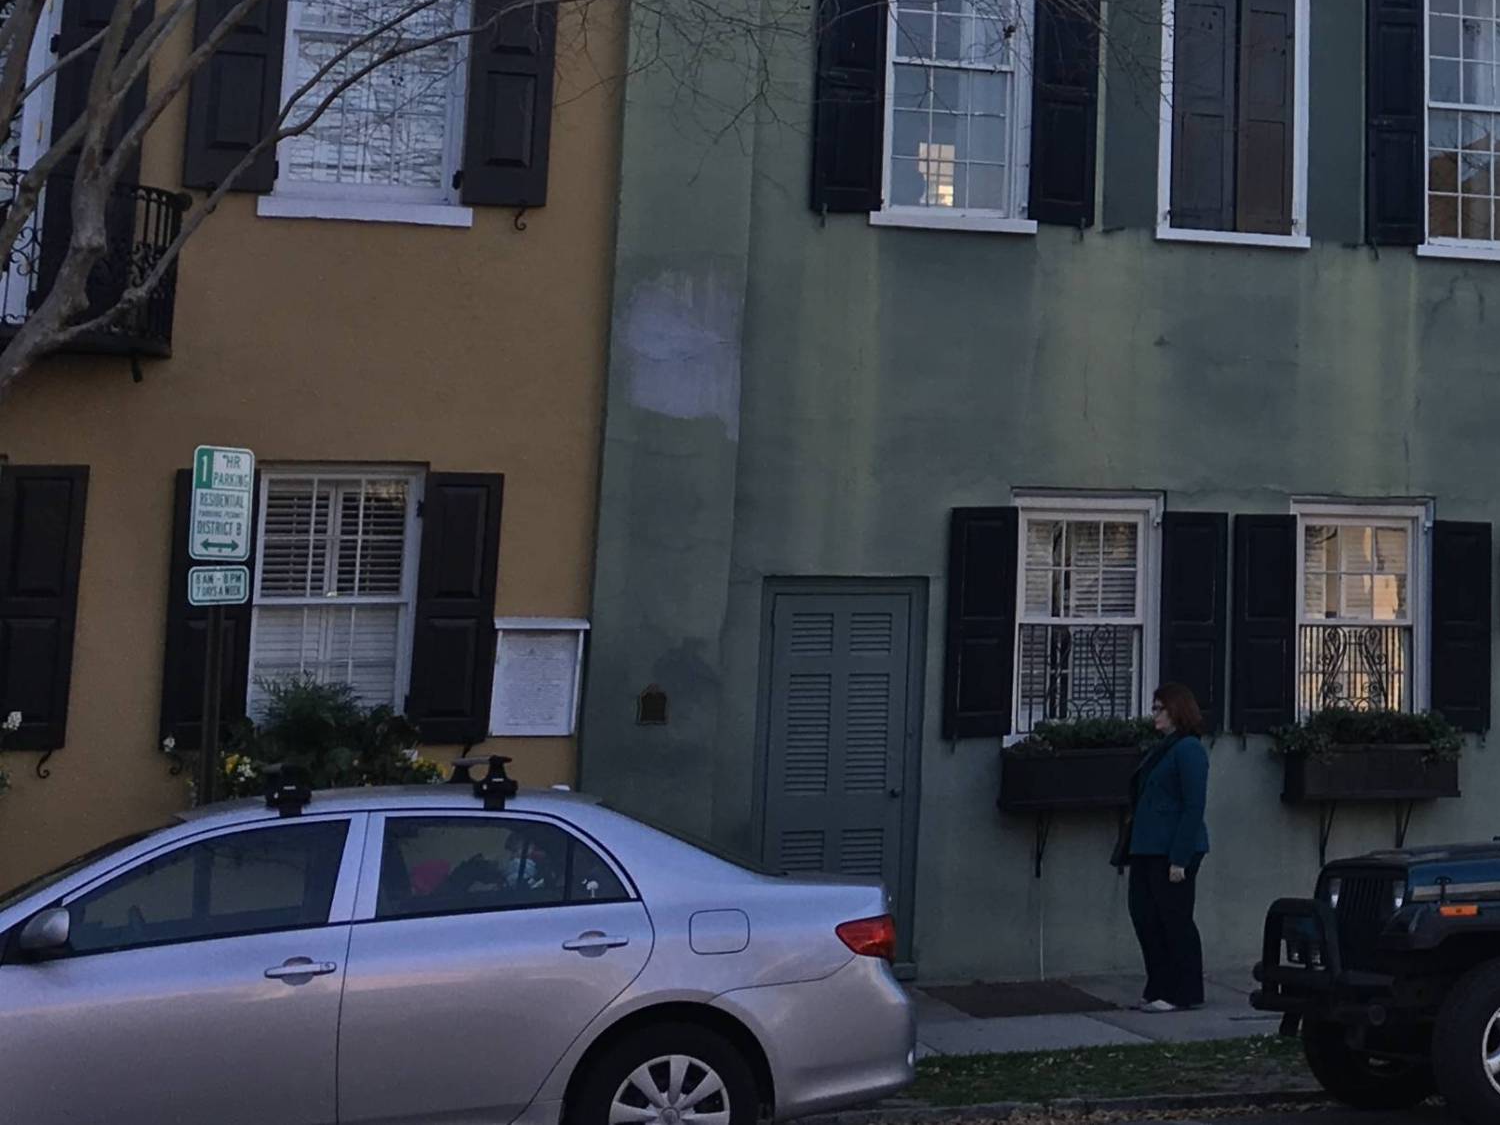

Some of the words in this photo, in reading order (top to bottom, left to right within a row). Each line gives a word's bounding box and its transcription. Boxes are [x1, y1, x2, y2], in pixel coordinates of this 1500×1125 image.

[202, 455, 208, 482] 1
[226, 455, 242, 469] HR
[213, 472, 249, 488] PARKING
[200, 492, 244, 509] RESIDENTIAL
[197, 520, 233, 536] DISTRICT
[203, 574, 214, 585] AM
[231, 573, 241, 584] PM
